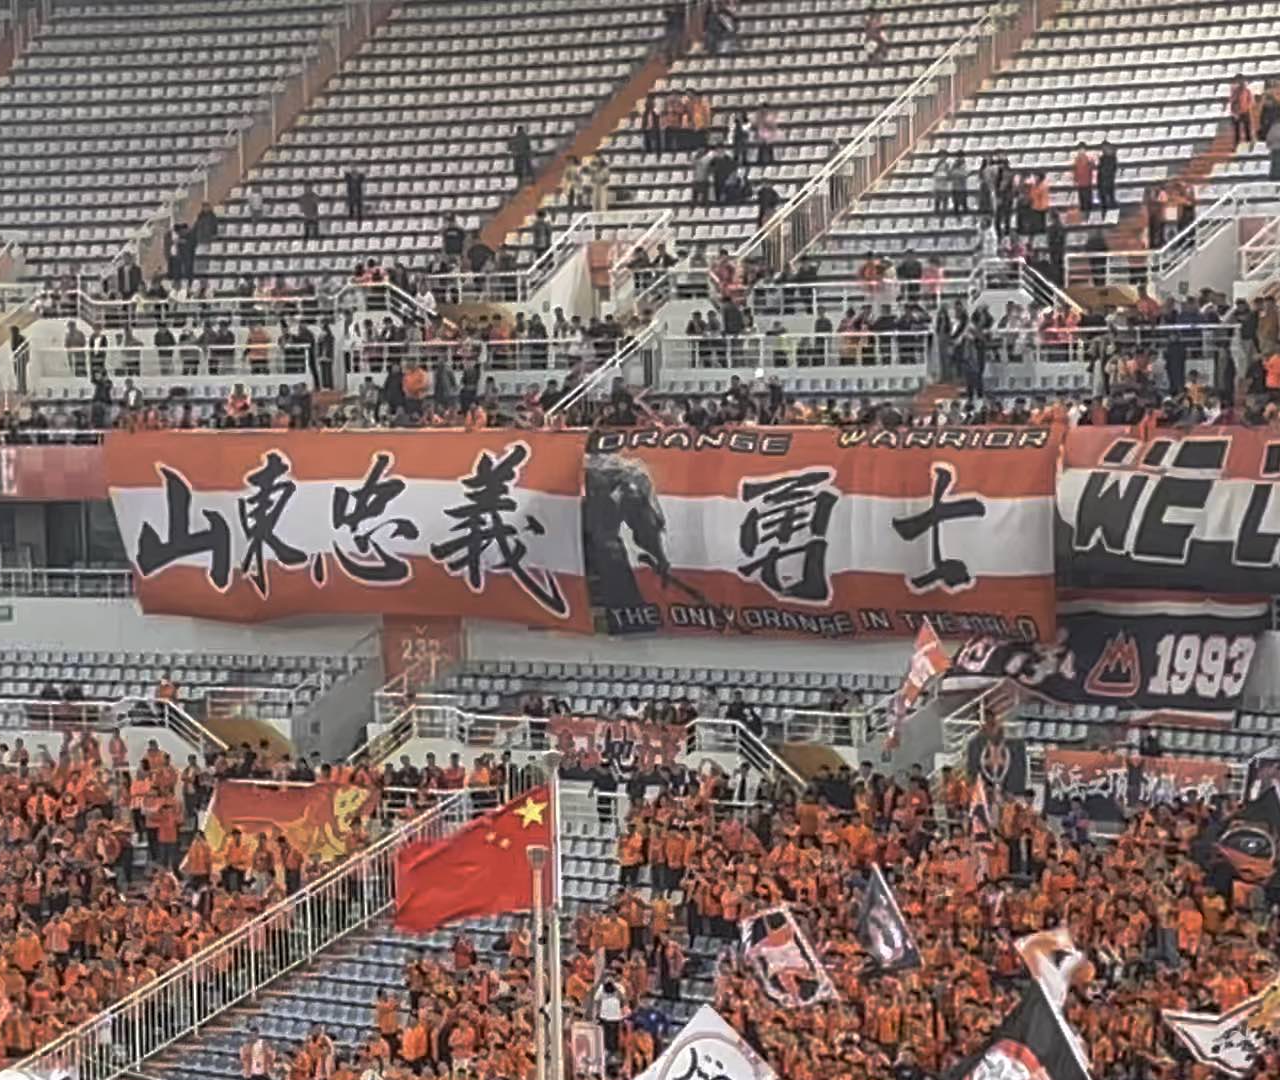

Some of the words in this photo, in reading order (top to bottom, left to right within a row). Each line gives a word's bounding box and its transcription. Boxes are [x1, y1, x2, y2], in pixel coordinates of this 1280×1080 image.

[596, 430, 792, 455] ORANGE
[839, 428, 1050, 450] WARRIOR
[136, 440, 570, 619] 山東忠義
[737, 464, 986, 605] 勇士
[1074, 438, 1231, 564] WE
[611, 606, 660, 627] THE
[671, 607, 735, 629] ONLY
[743, 608, 852, 635] ORANGE
[861, 609, 889, 630] IN
[1147, 634, 1256, 697] 1993
